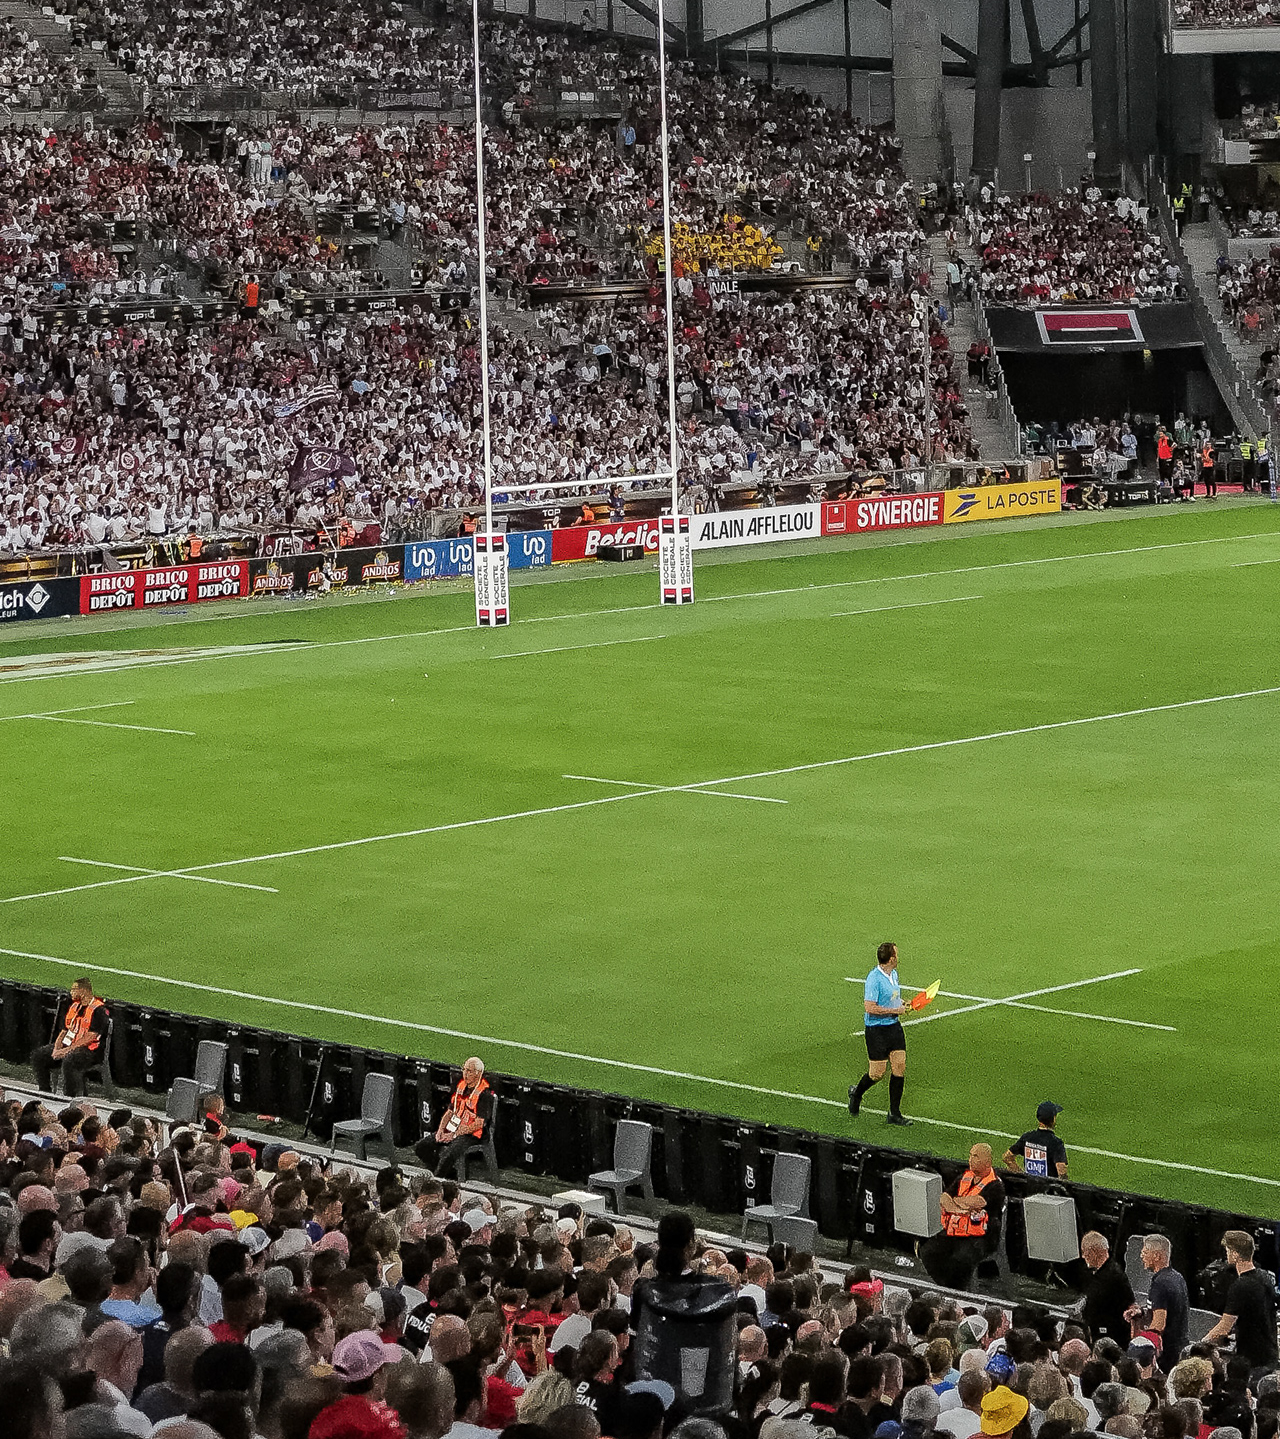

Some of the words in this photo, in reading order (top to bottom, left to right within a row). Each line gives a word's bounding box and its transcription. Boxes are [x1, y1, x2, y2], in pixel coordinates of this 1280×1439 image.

[987, 494, 1005, 511] LA
[1008, 489, 1056, 507] POSTE
[857, 497, 939, 528] SYNERGIE
[700, 518, 745, 541] ALAIN
[747, 511, 814, 537] AFFLELOU
[145, 569, 188, 587] BRICO
[199, 564, 240, 581] BRICO
[363, 564, 399, 577] ANDROS
[91, 575, 135, 592] BRICO
[198, 578, 240, 599] DEPÔT
[90, 589, 134, 610] DEPÔT
[145, 584, 188, 604] DEPÔT
